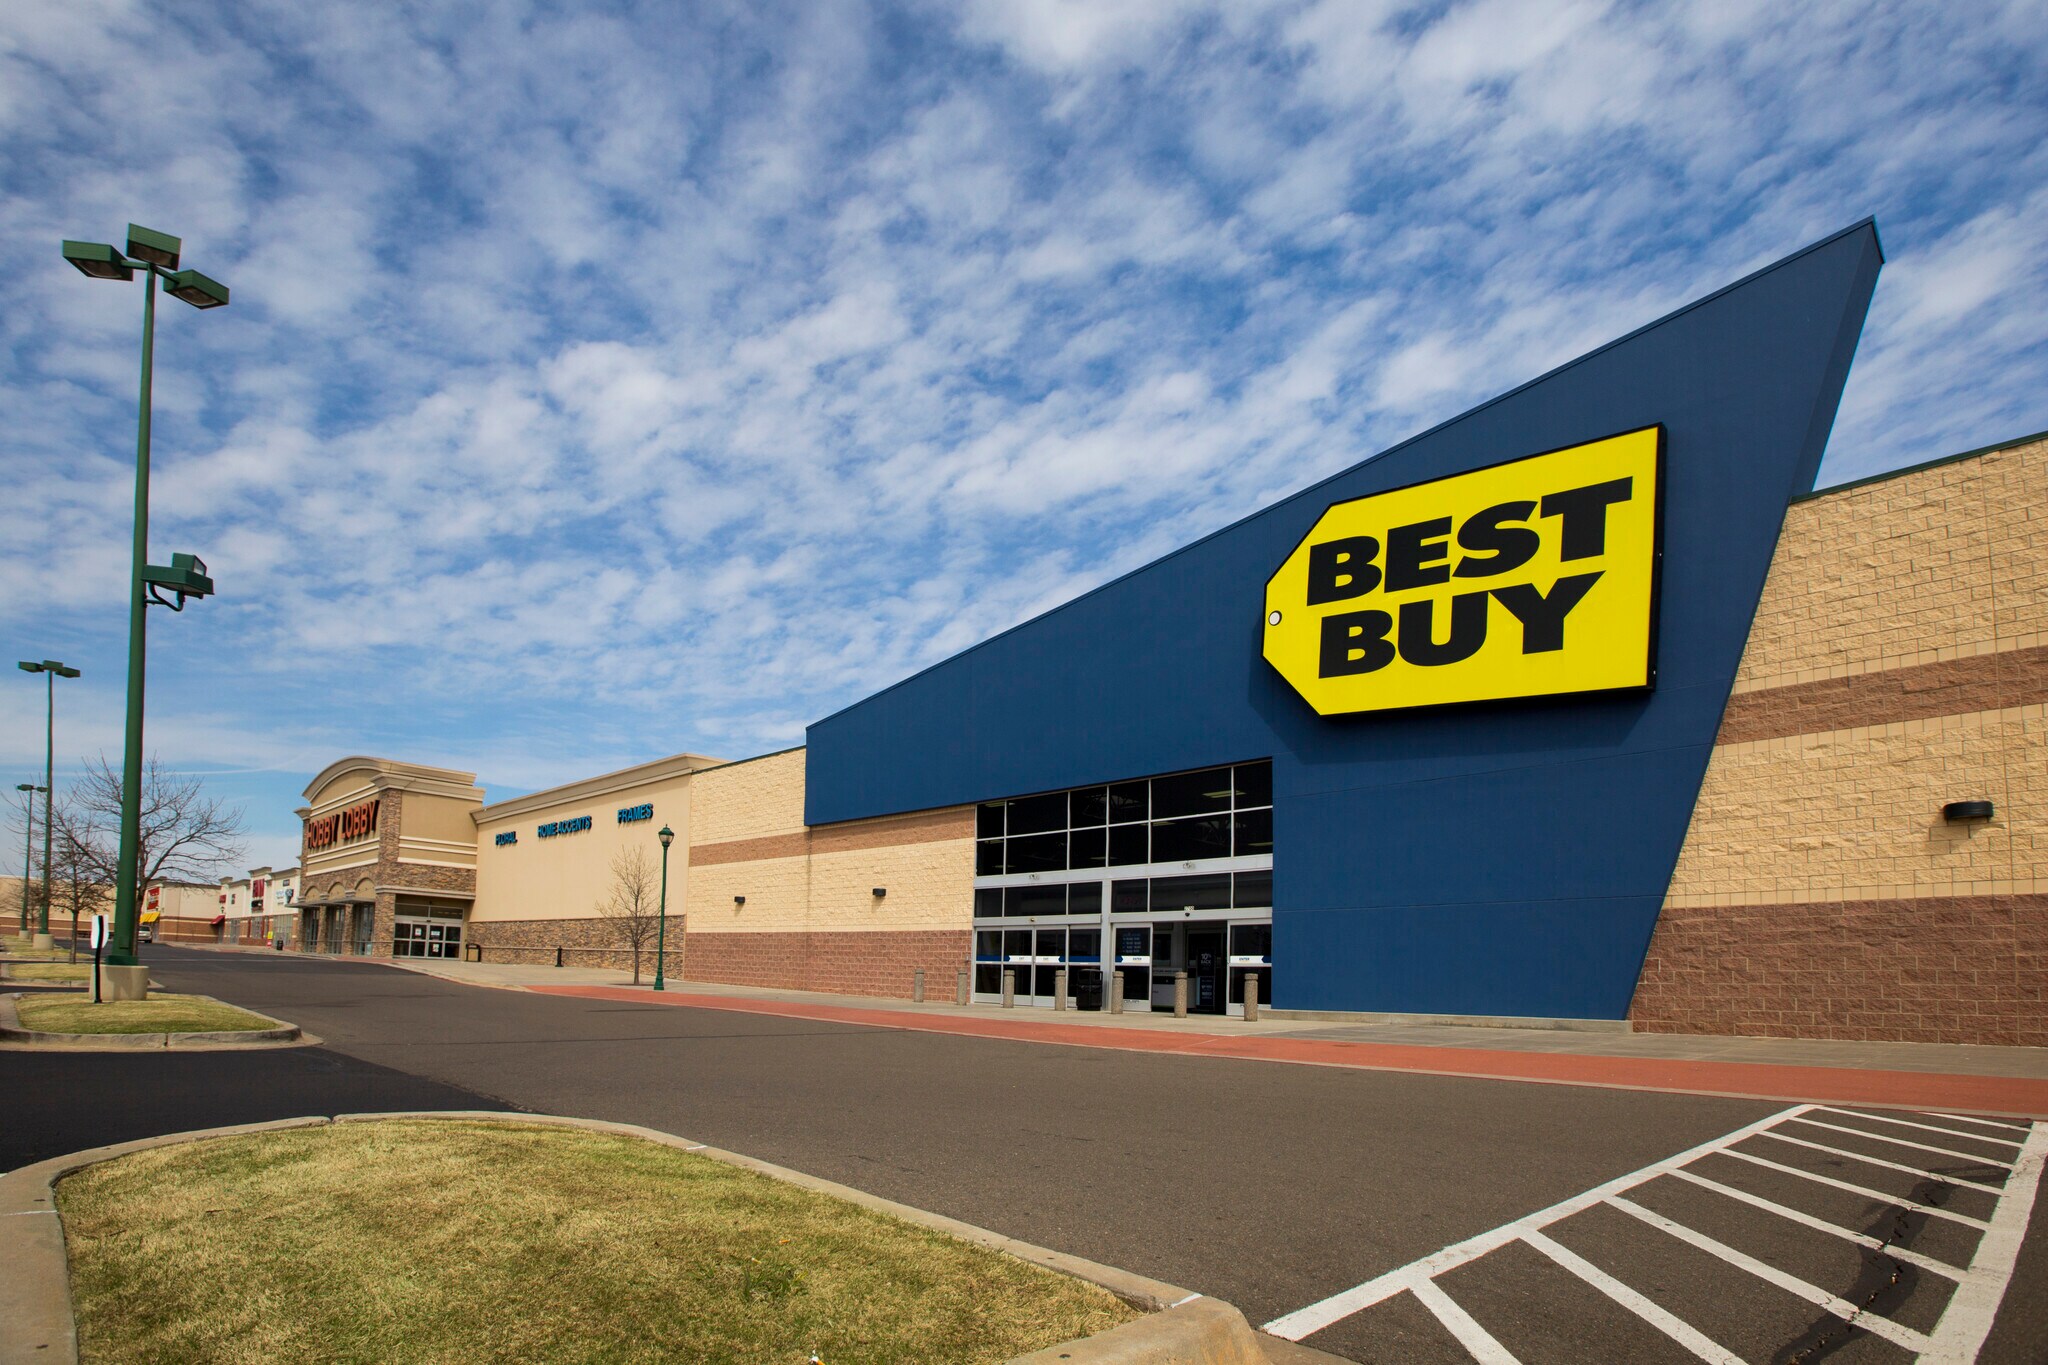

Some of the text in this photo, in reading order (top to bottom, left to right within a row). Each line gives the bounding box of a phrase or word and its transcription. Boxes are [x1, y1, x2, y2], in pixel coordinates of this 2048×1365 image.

[1307, 476, 1633, 607] BEST
[1318, 570, 1606, 679] BUY
[306, 799, 380, 850] HOBBY LOBBY
[537, 815, 592, 838] HOME ACCENTS
[617, 803, 653, 824] FRAMES
[495, 831, 517, 846] FLORAL
